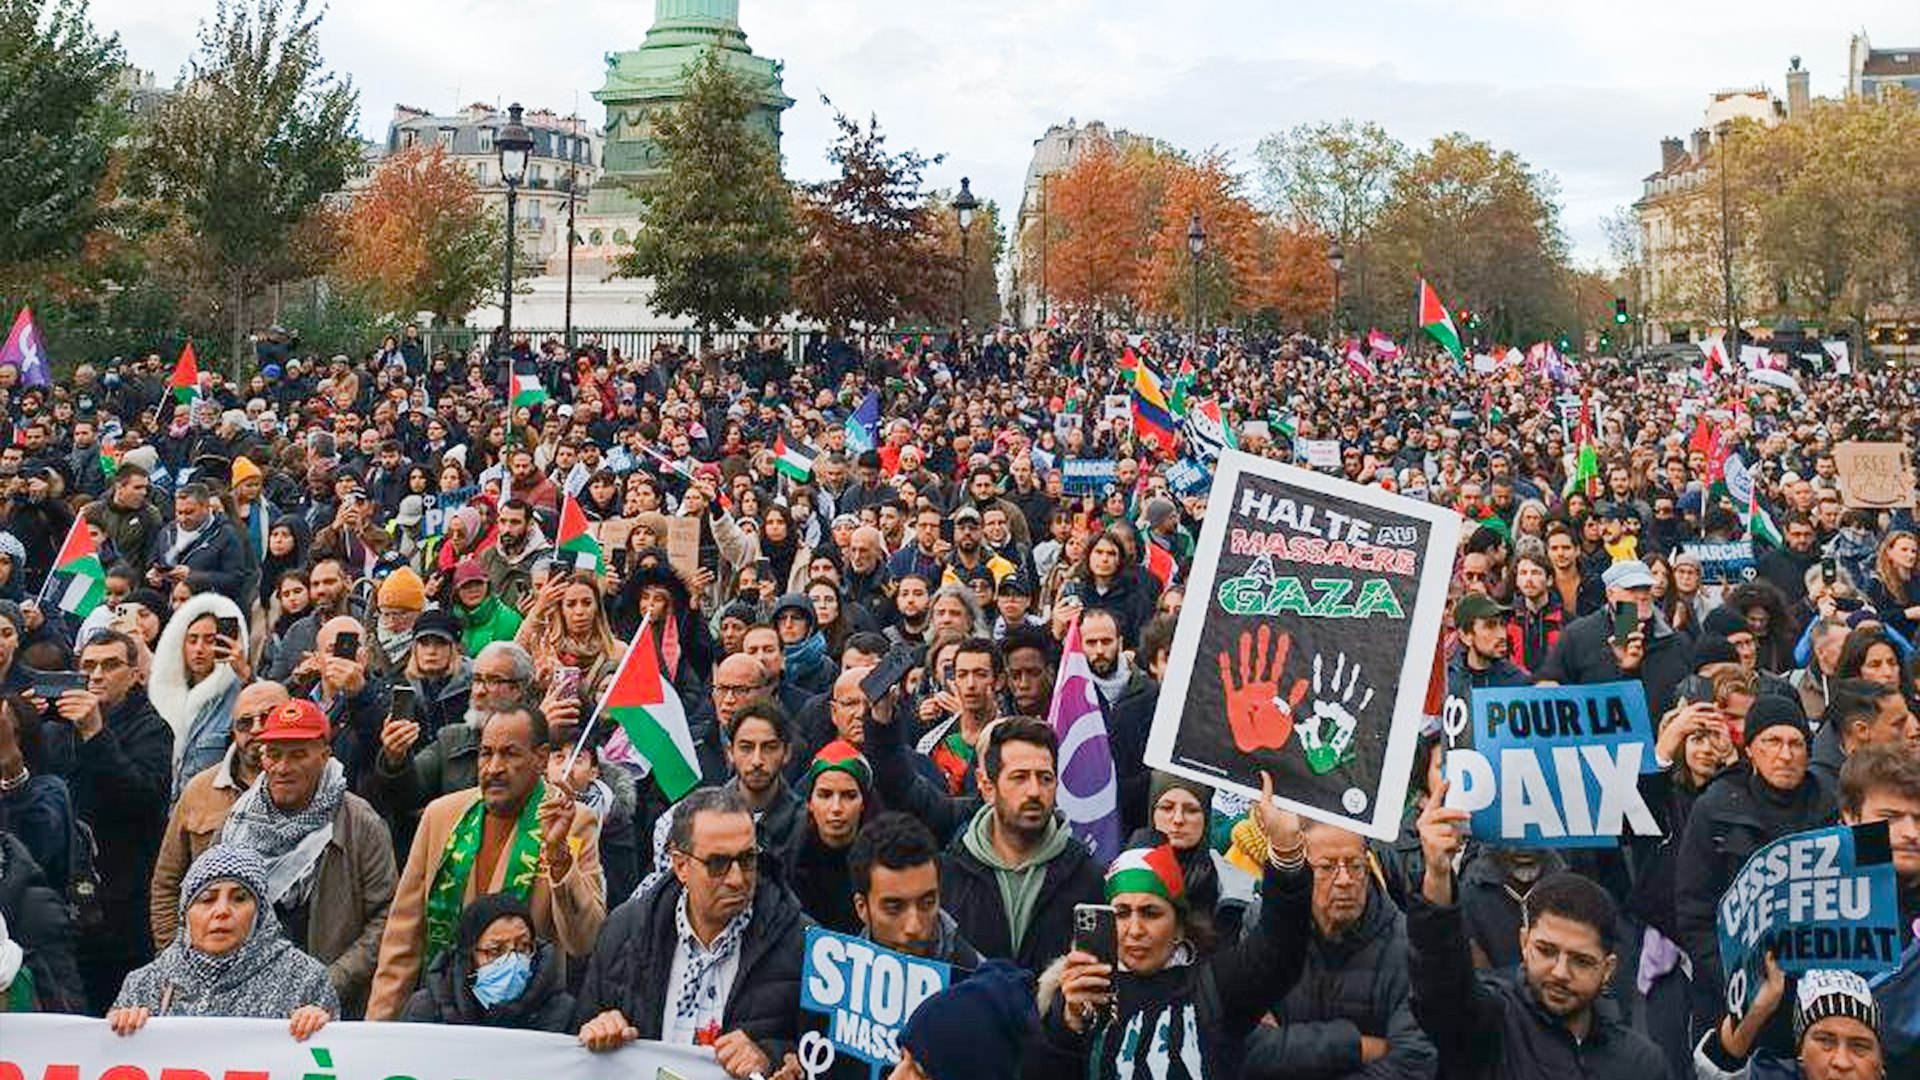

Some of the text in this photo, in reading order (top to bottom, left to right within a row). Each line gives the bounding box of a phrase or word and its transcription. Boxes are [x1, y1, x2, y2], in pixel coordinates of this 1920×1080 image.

[1239, 489, 1418, 547] HALTE AU
[1230, 528, 1417, 575] MASSACRE
[1682, 542, 1753, 560] MARCHE
[1217, 576, 1405, 618] GAZA
[1487, 696, 1633, 738] POUR LA
[1445, 742, 1664, 838] PAIX
[1723, 835, 1841, 936] CESSEZ
[1742, 877, 1871, 947] LE-FEU
[809, 936, 942, 1026] STOP
